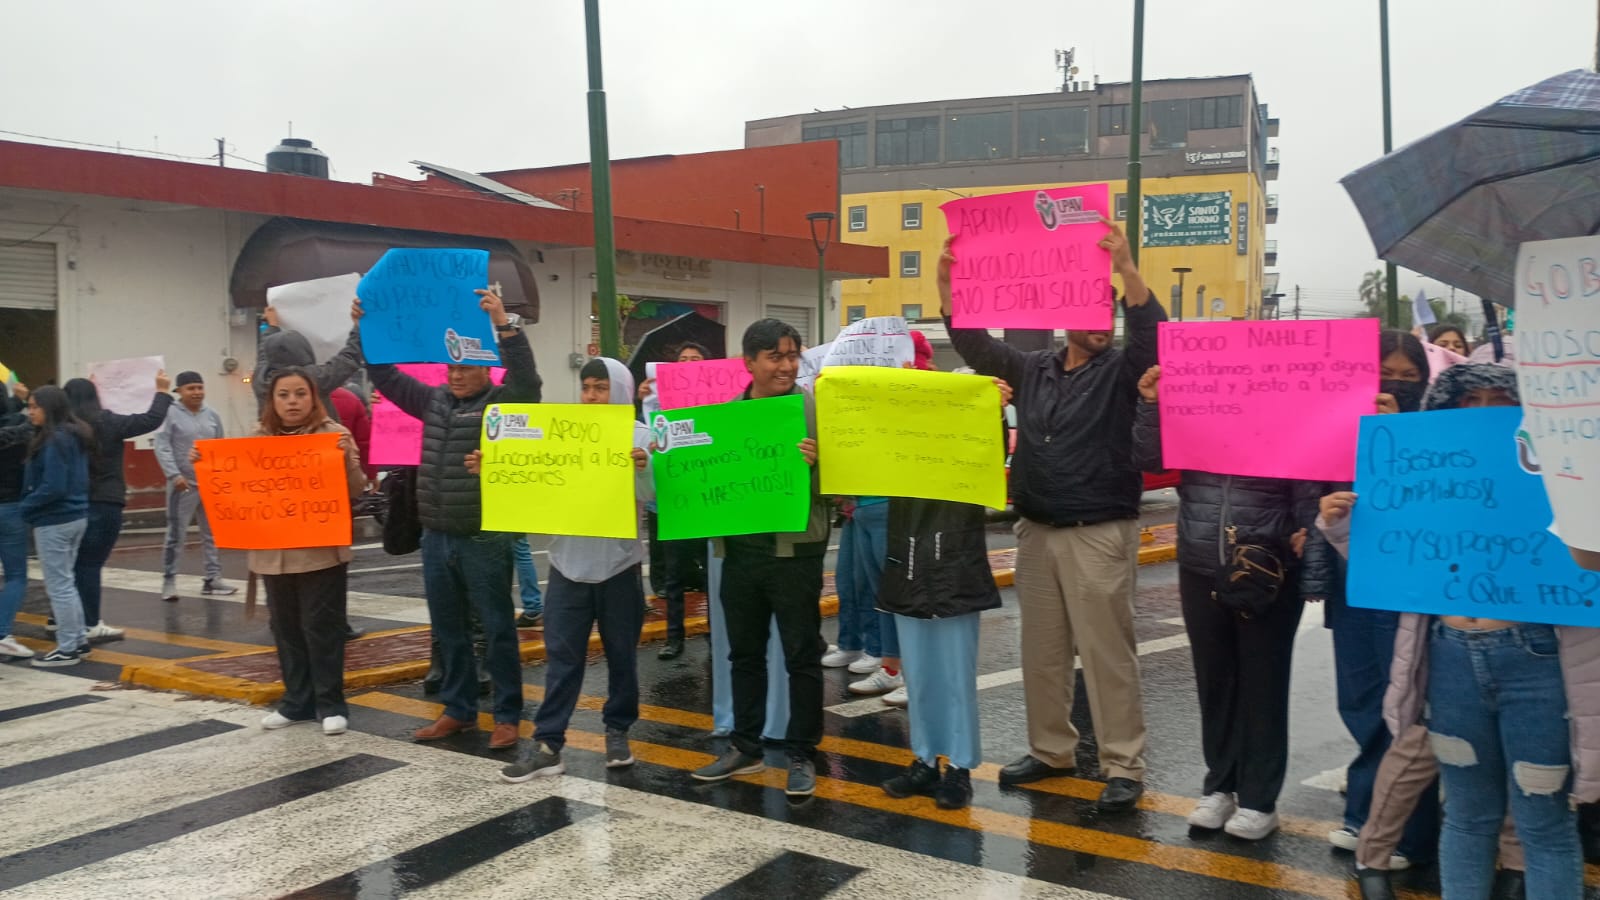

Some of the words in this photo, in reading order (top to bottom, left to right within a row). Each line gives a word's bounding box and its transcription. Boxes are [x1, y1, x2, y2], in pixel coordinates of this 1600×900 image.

[959, 206, 1018, 237] APOYO
[1188, 205, 1220, 215] SANTO
[1188, 215, 1220, 224] HORNO
[1238, 206, 1246, 251] HOTEL
[1261, 364, 1280, 374] un
[1287, 361, 1325, 377] pago
[1163, 379, 1219, 397] puntual
[1227, 382, 1237, 395] y
[1244, 377, 1288, 396] justo
[1298, 381, 1310, 391] a
[1320, 377, 1351, 392] los
[549, 416, 601, 444] APOYO
[210, 449, 238, 473] La
[589, 452, 601, 466] a
[606, 447, 630, 468] los
[1368, 424, 1477, 476] Asesores
[210, 476, 233, 495] Se
[240, 472, 304, 498] respeta
[309, 472, 325, 490] el
[486, 469, 567, 487] asesores
[214, 500, 274, 521] Salario
[278, 497, 297, 518] Se
[301, 499, 340, 524] paga
